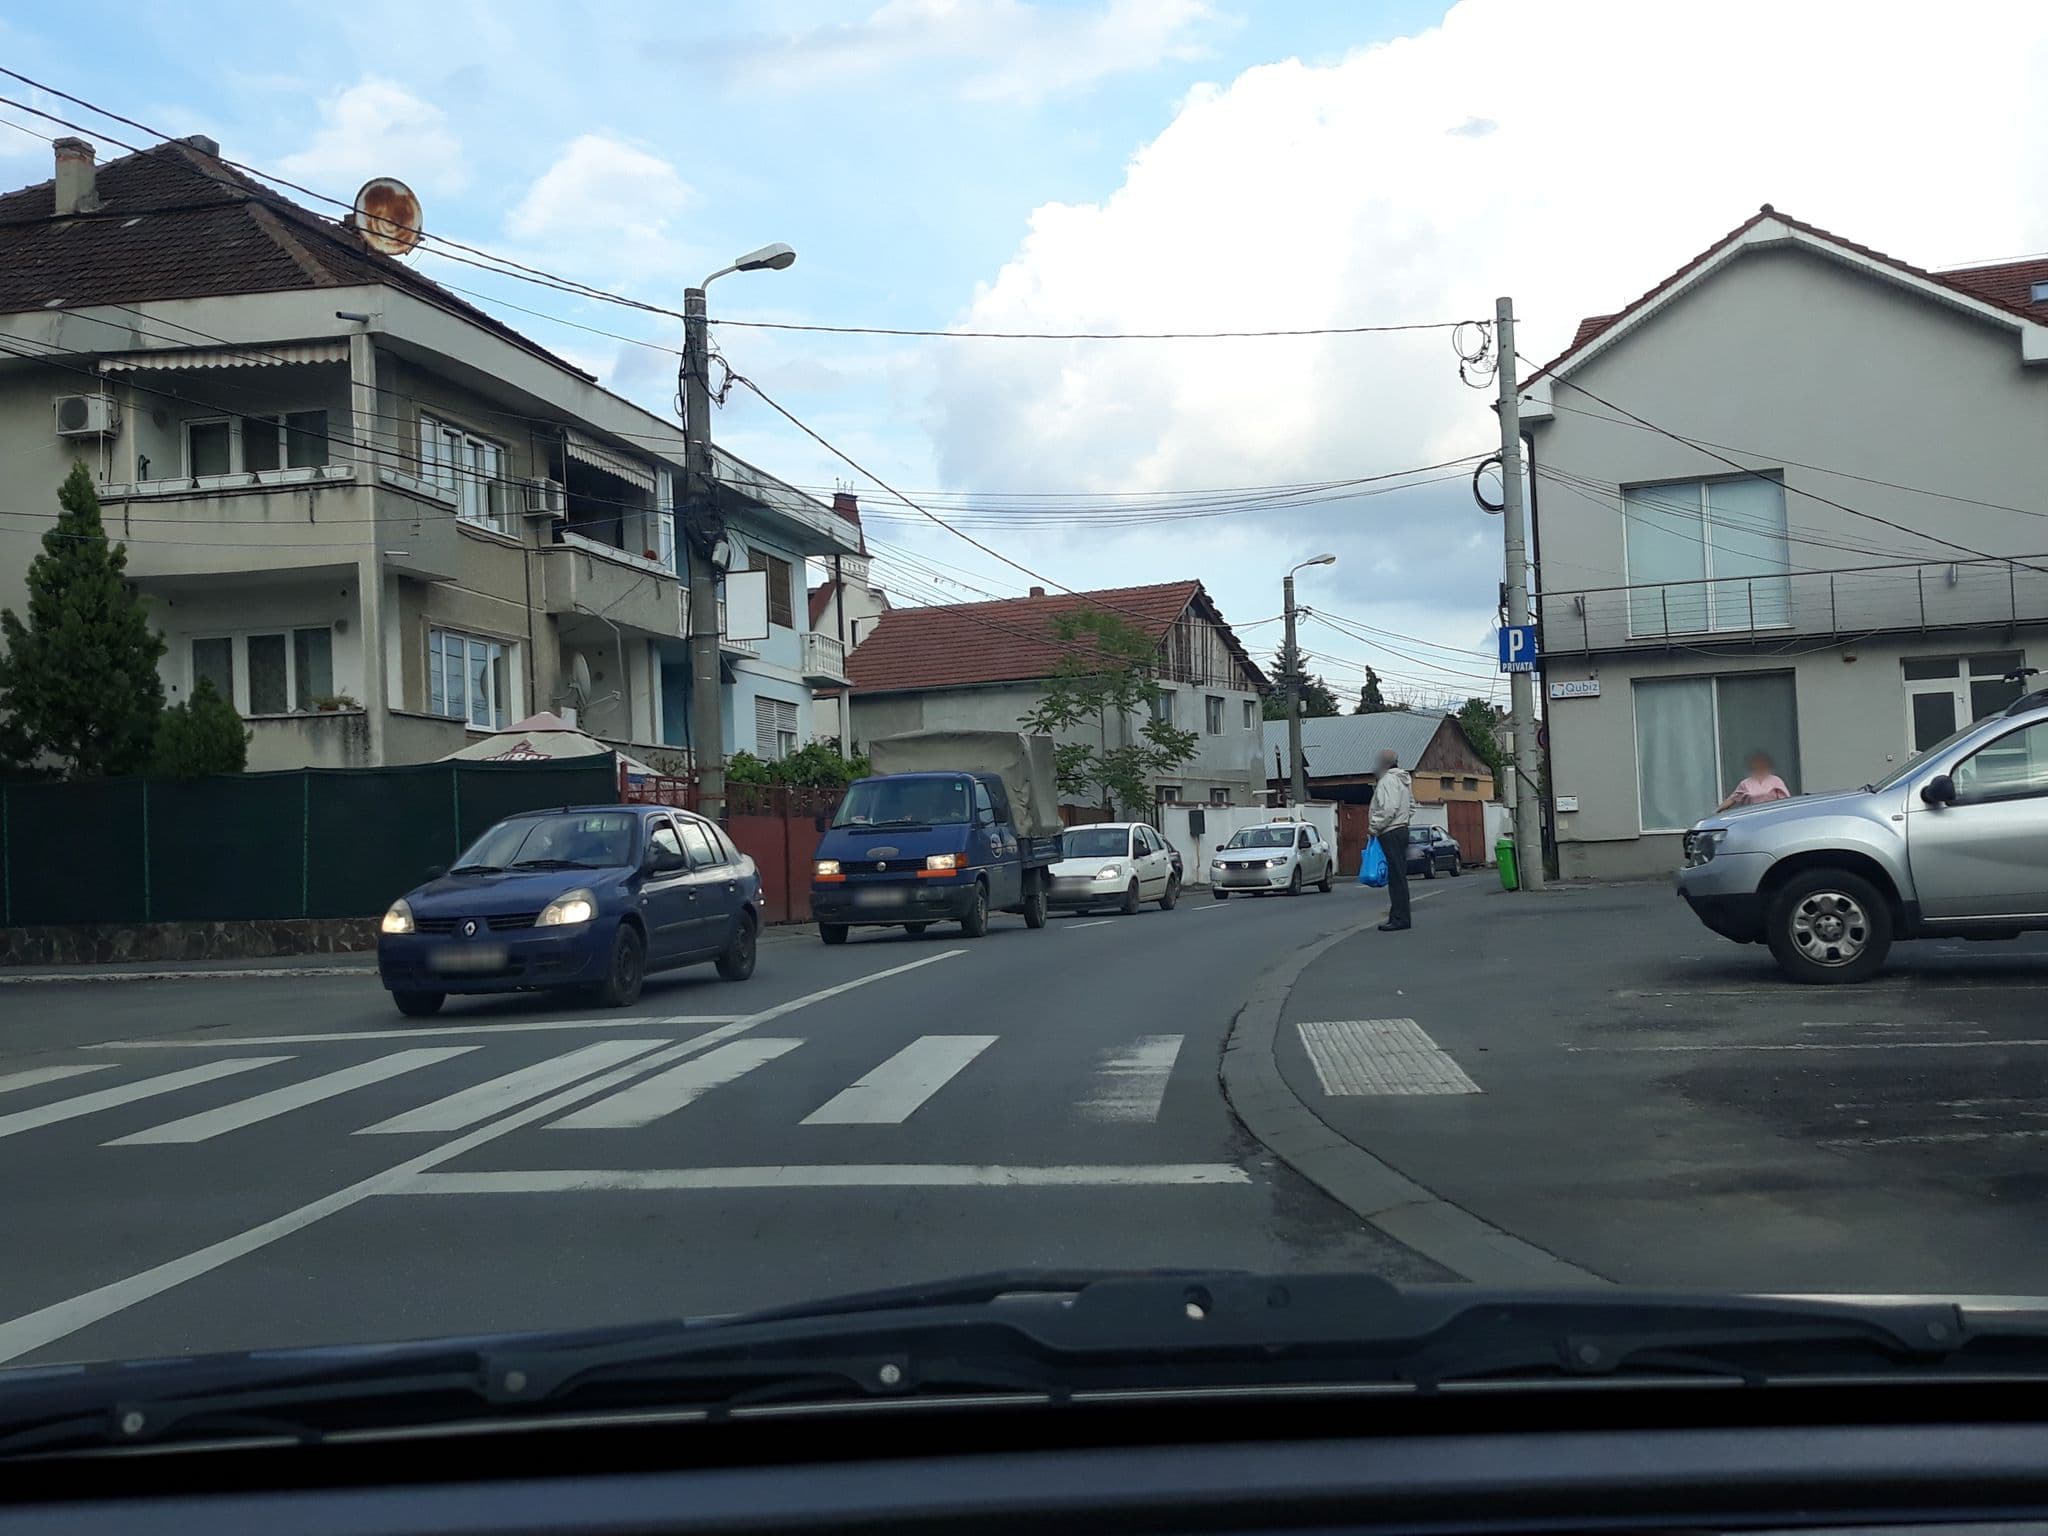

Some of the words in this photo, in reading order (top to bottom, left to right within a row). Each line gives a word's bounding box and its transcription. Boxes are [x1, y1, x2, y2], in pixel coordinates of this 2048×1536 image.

[1509, 629, 1523, 662] P
[1502, 661, 1534, 671] PRIVATA
[1565, 682, 1598, 692] Qubiz
